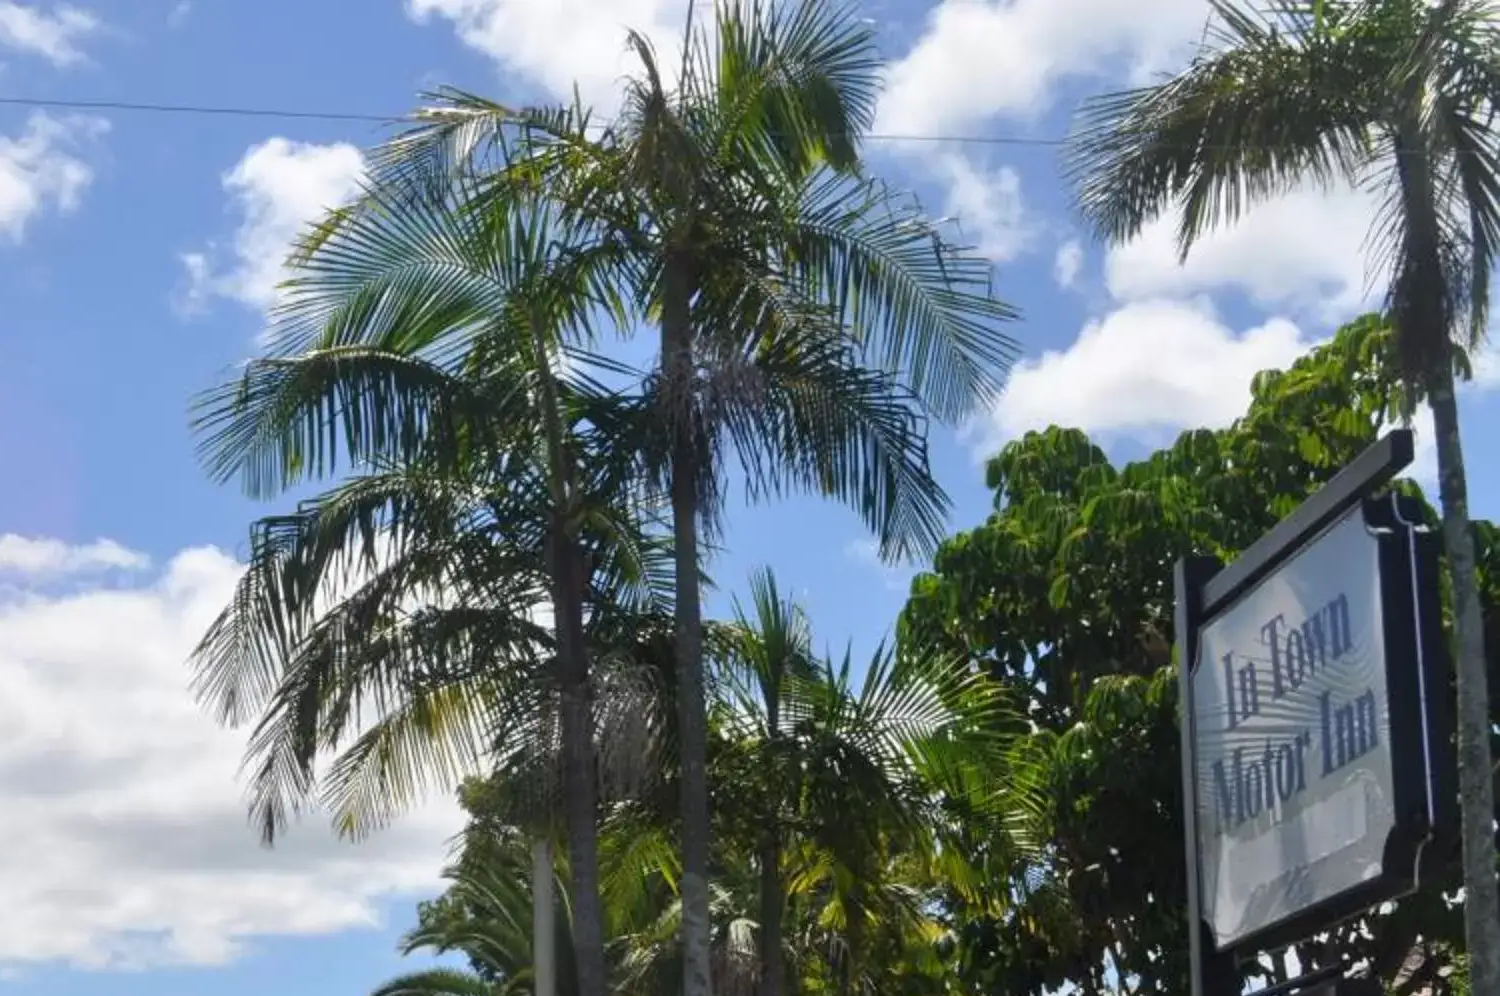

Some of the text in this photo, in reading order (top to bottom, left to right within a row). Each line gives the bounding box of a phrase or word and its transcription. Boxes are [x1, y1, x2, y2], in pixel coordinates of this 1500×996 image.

[1222, 592, 1354, 731] In Town
[1211, 686, 1380, 832] Motor Inn
